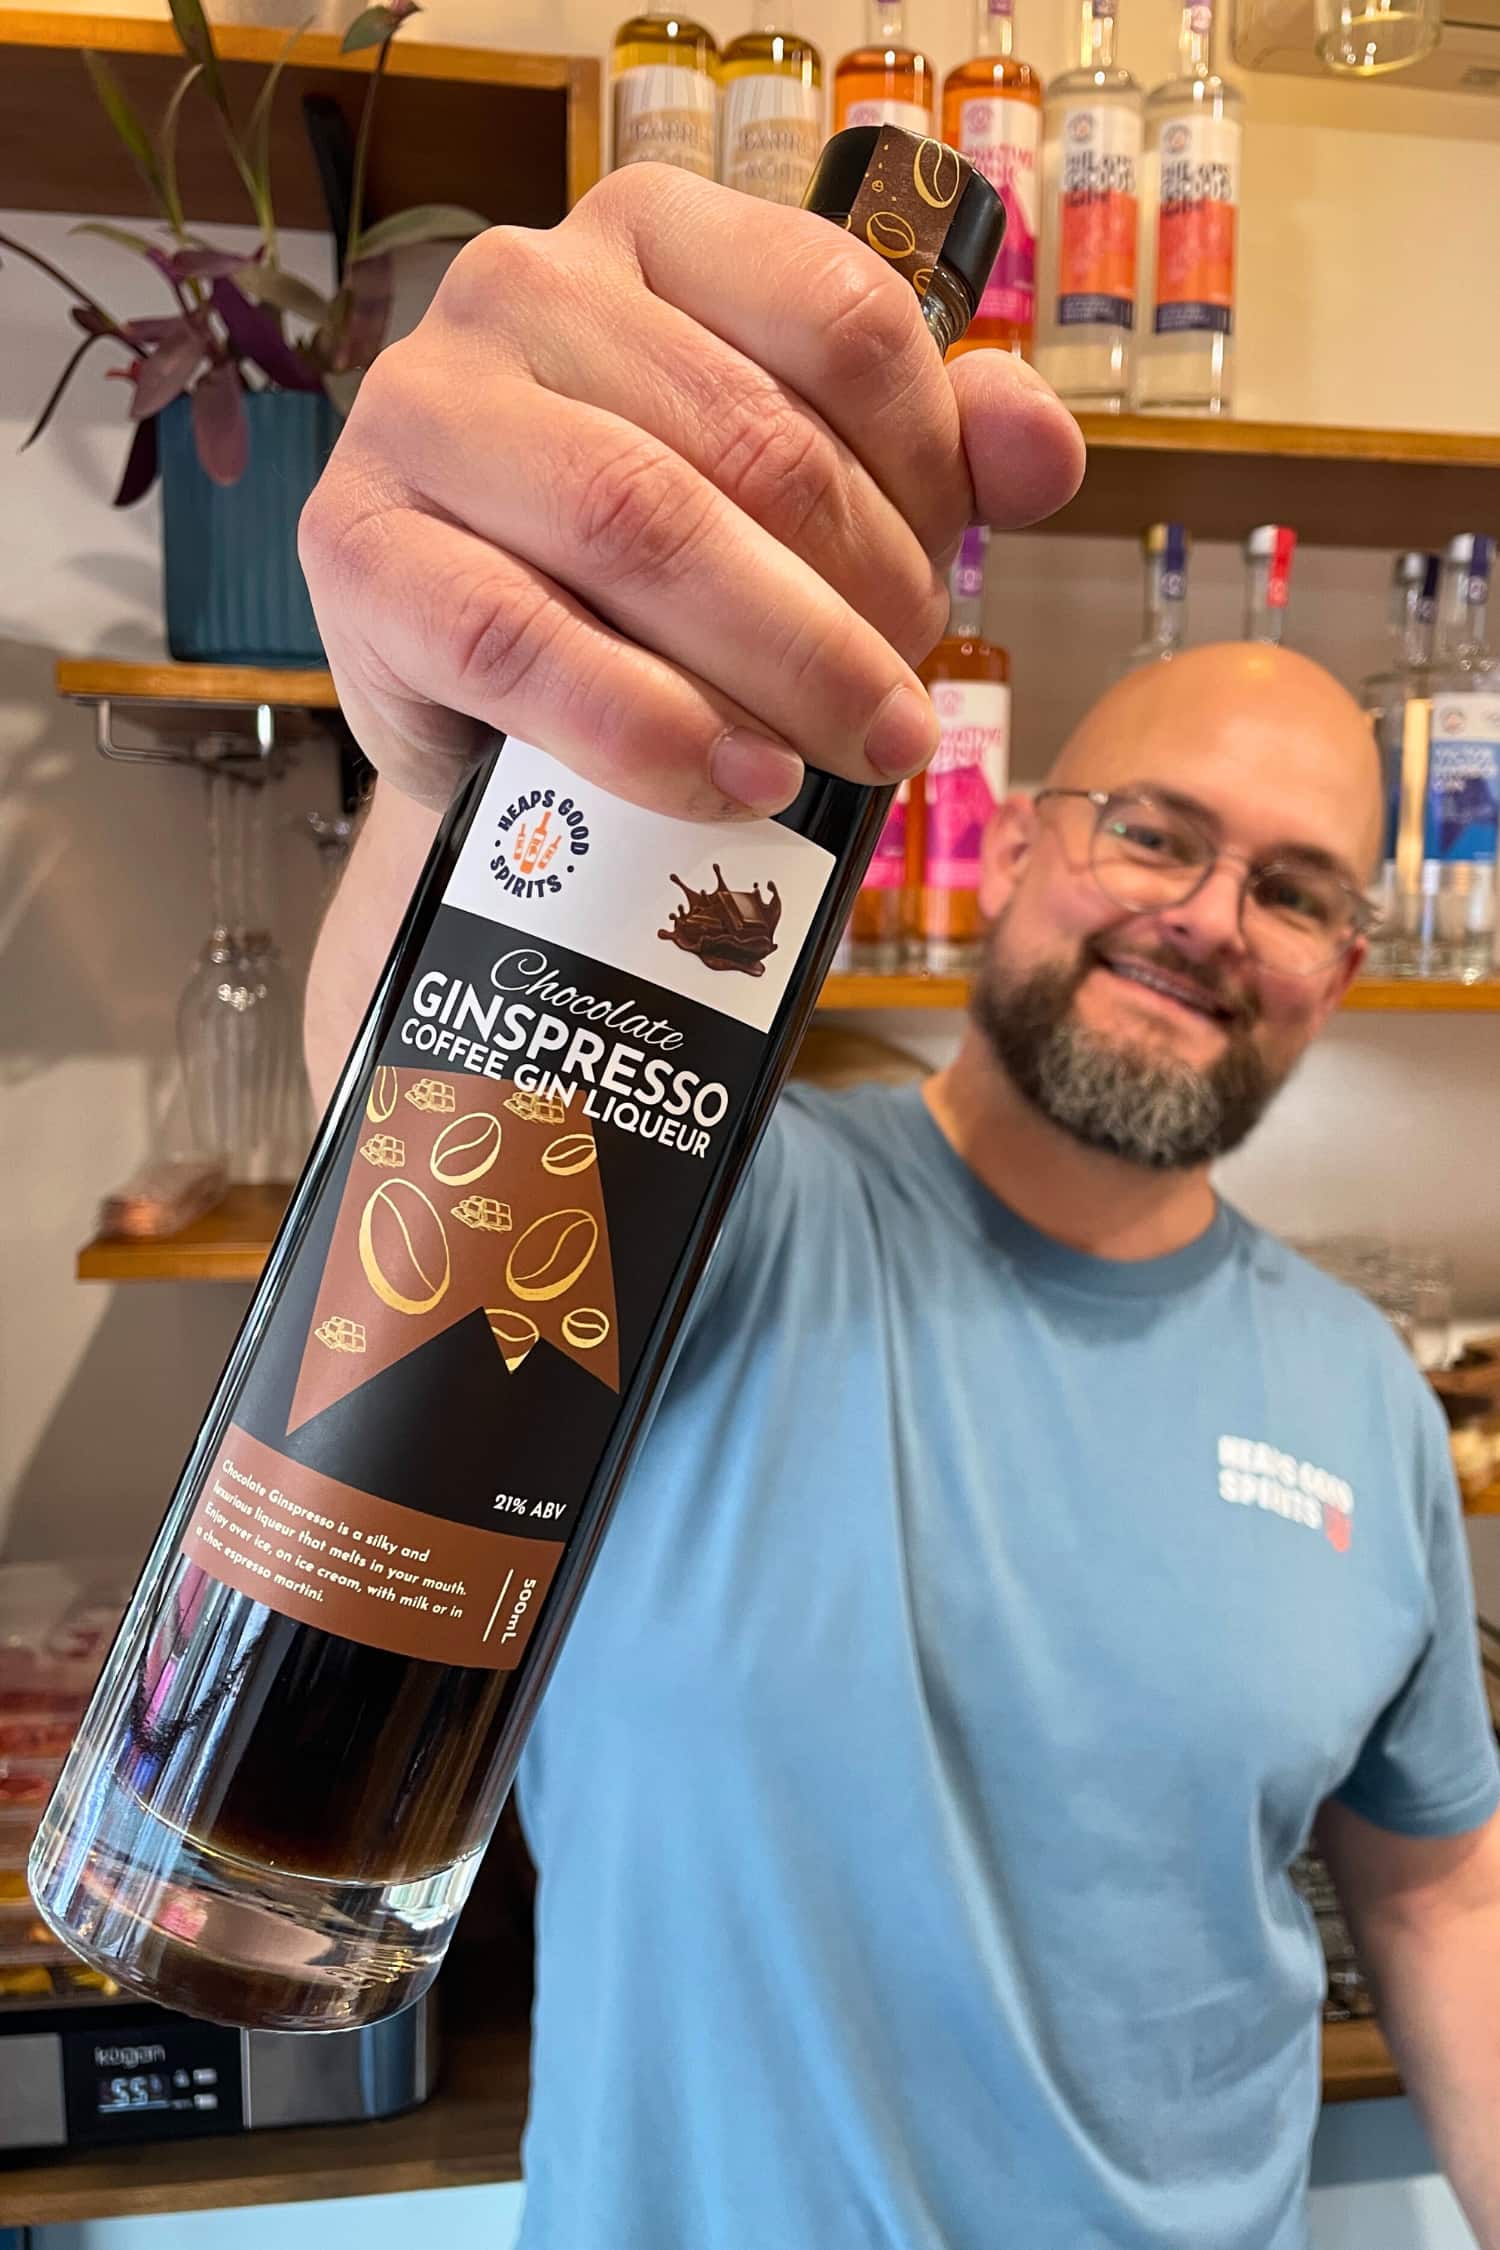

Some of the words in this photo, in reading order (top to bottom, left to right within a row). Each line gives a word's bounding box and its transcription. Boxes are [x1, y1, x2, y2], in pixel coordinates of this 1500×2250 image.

[497, 789, 556, 832] HEAPS
[558, 798, 590, 856] GOOD
[490, 855, 562, 898] SPIRITS
[490, 948, 685, 1051] Chocolate
[401, 1018, 510, 1081] COFFEE
[513, 1064, 579, 1109] GIN
[583, 1089, 711, 1159] LIQUEUR
[413, 971, 729, 1128] GINSPRESSO
[222, 1459, 266, 1497] Chocolate
[268, 1489, 335, 1530] Ginspresso
[337, 1521, 349, 1536] is
[352, 1530, 363, 1541] a
[365, 1534, 398, 1555] silky
[401, 1548, 431, 1562] and
[254, 1506, 296, 1537] liqueur
[298, 1530, 327, 1551] that
[328, 1546, 366, 1567] melts
[369, 1559, 384, 1573] in
[386, 1567, 420, 1584] your
[422, 1578, 467, 1595] mouth.
[493, 1494, 528, 1515] 21%
[529, 1500, 567, 1520] ABV
[196, 1525, 204, 1537] a
[203, 1529, 224, 1551] choc
[224, 1547, 272, 1578] espresso
[273, 1573, 324, 1602] martini.
[205, 1501, 228, 1528] Enjoy
[229, 1523, 253, 1541] over
[254, 1535, 273, 1555] ice,
[275, 1549, 293, 1562] on
[295, 1555, 315, 1572] ice
[317, 1567, 362, 1593] cream,
[367, 1585, 396, 1601] with
[400, 1595, 430, 1611] milk
[432, 1603, 448, 1614] or
[450, 1605, 463, 1618] in
[501, 1578, 537, 1645] 500mL
